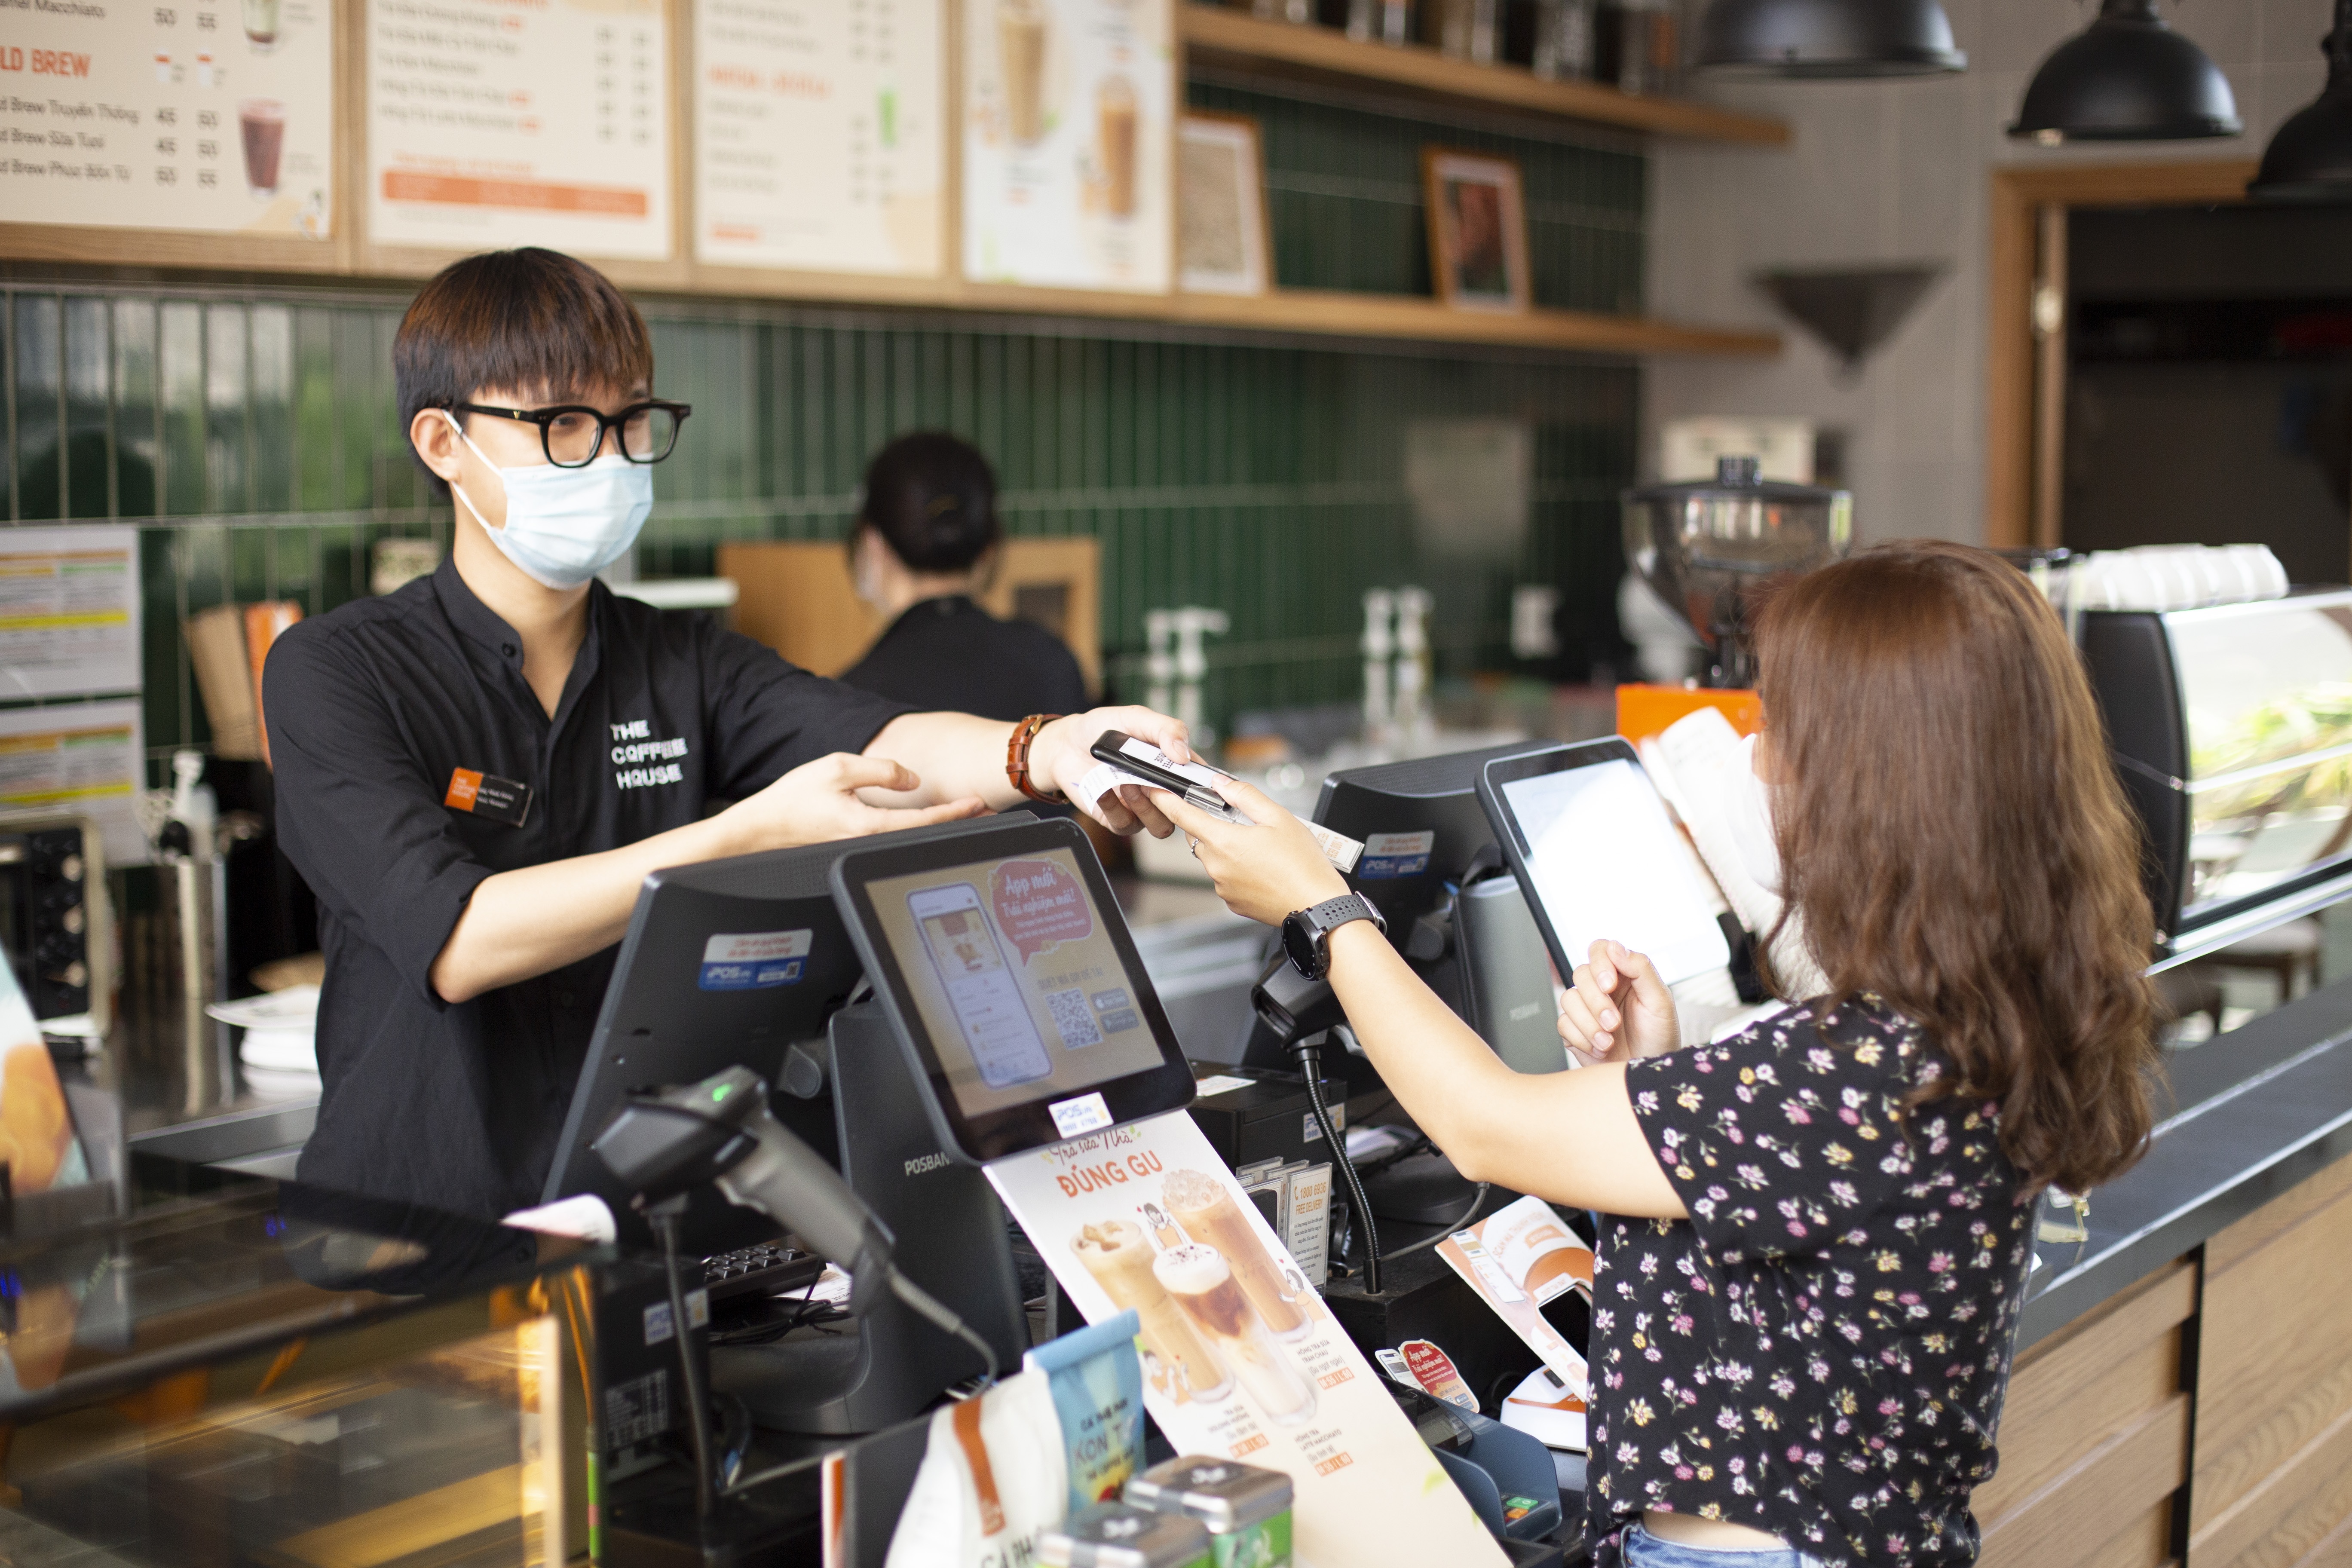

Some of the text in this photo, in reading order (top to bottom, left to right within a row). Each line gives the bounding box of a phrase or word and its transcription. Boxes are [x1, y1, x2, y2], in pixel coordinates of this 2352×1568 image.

[31, 48, 91, 78] BREW
[11, 96, 45, 114] Brew
[11, 127, 46, 145] Brew
[11, 158, 46, 177] Brew
[609, 720, 651, 741] THE
[611, 737, 688, 765] COFFEE
[616, 763, 683, 790] HOUSE
[1005, 866, 1057, 899] App mới
[1023, 895, 1055, 916] nghiệm
[1055, 887, 1076, 905] mới!
[1048, 1128, 1133, 1166] Trà sữa Nhà
[1056, 1150, 1163, 1198] ĐÚNG GU
[1300, 1182, 1326, 1199] 1800 6936
[1296, 1198, 1323, 1216] FREE DELIVERY
